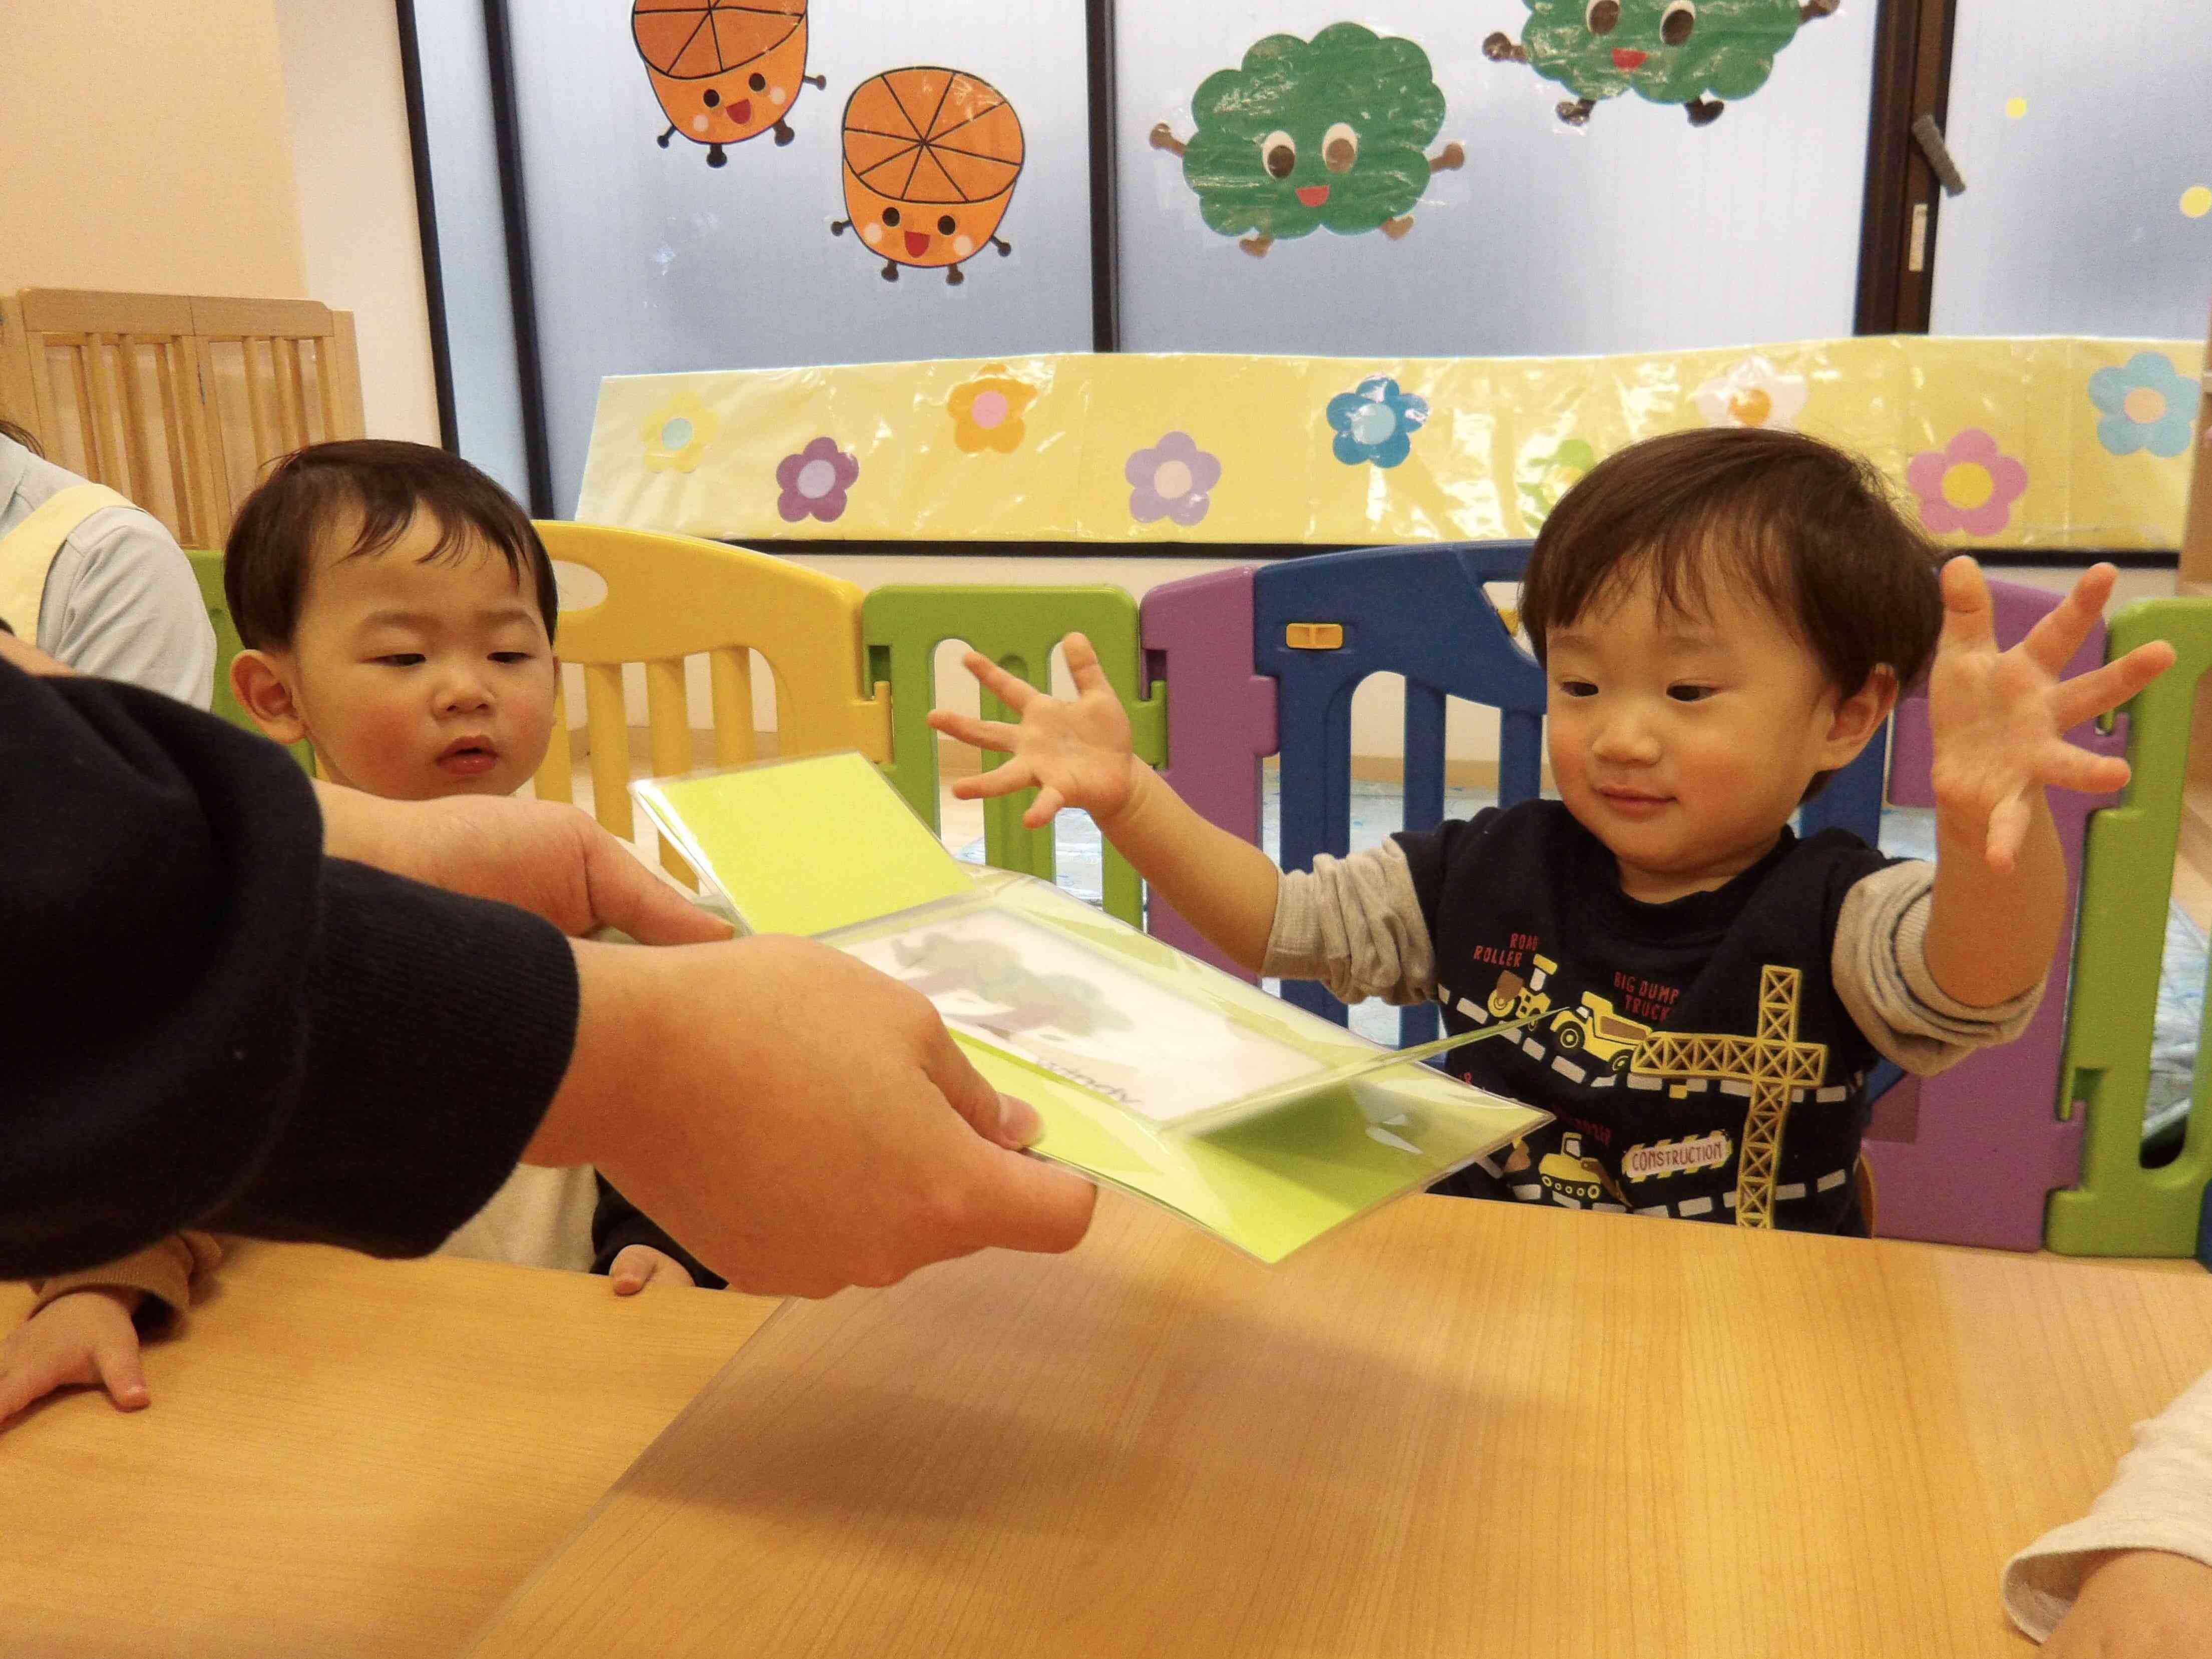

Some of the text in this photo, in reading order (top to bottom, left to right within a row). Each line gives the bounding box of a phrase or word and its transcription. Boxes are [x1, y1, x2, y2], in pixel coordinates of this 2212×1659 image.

[1510, 933, 1539, 951] ROAD
[1473, 945, 1523, 968] ROLLER
[1614, 971, 1680, 1005] BIG DUMP
[1625, 995, 1671, 1022] TRUCK
[1632, 1142, 1722, 1171] CONSTRUCTION
